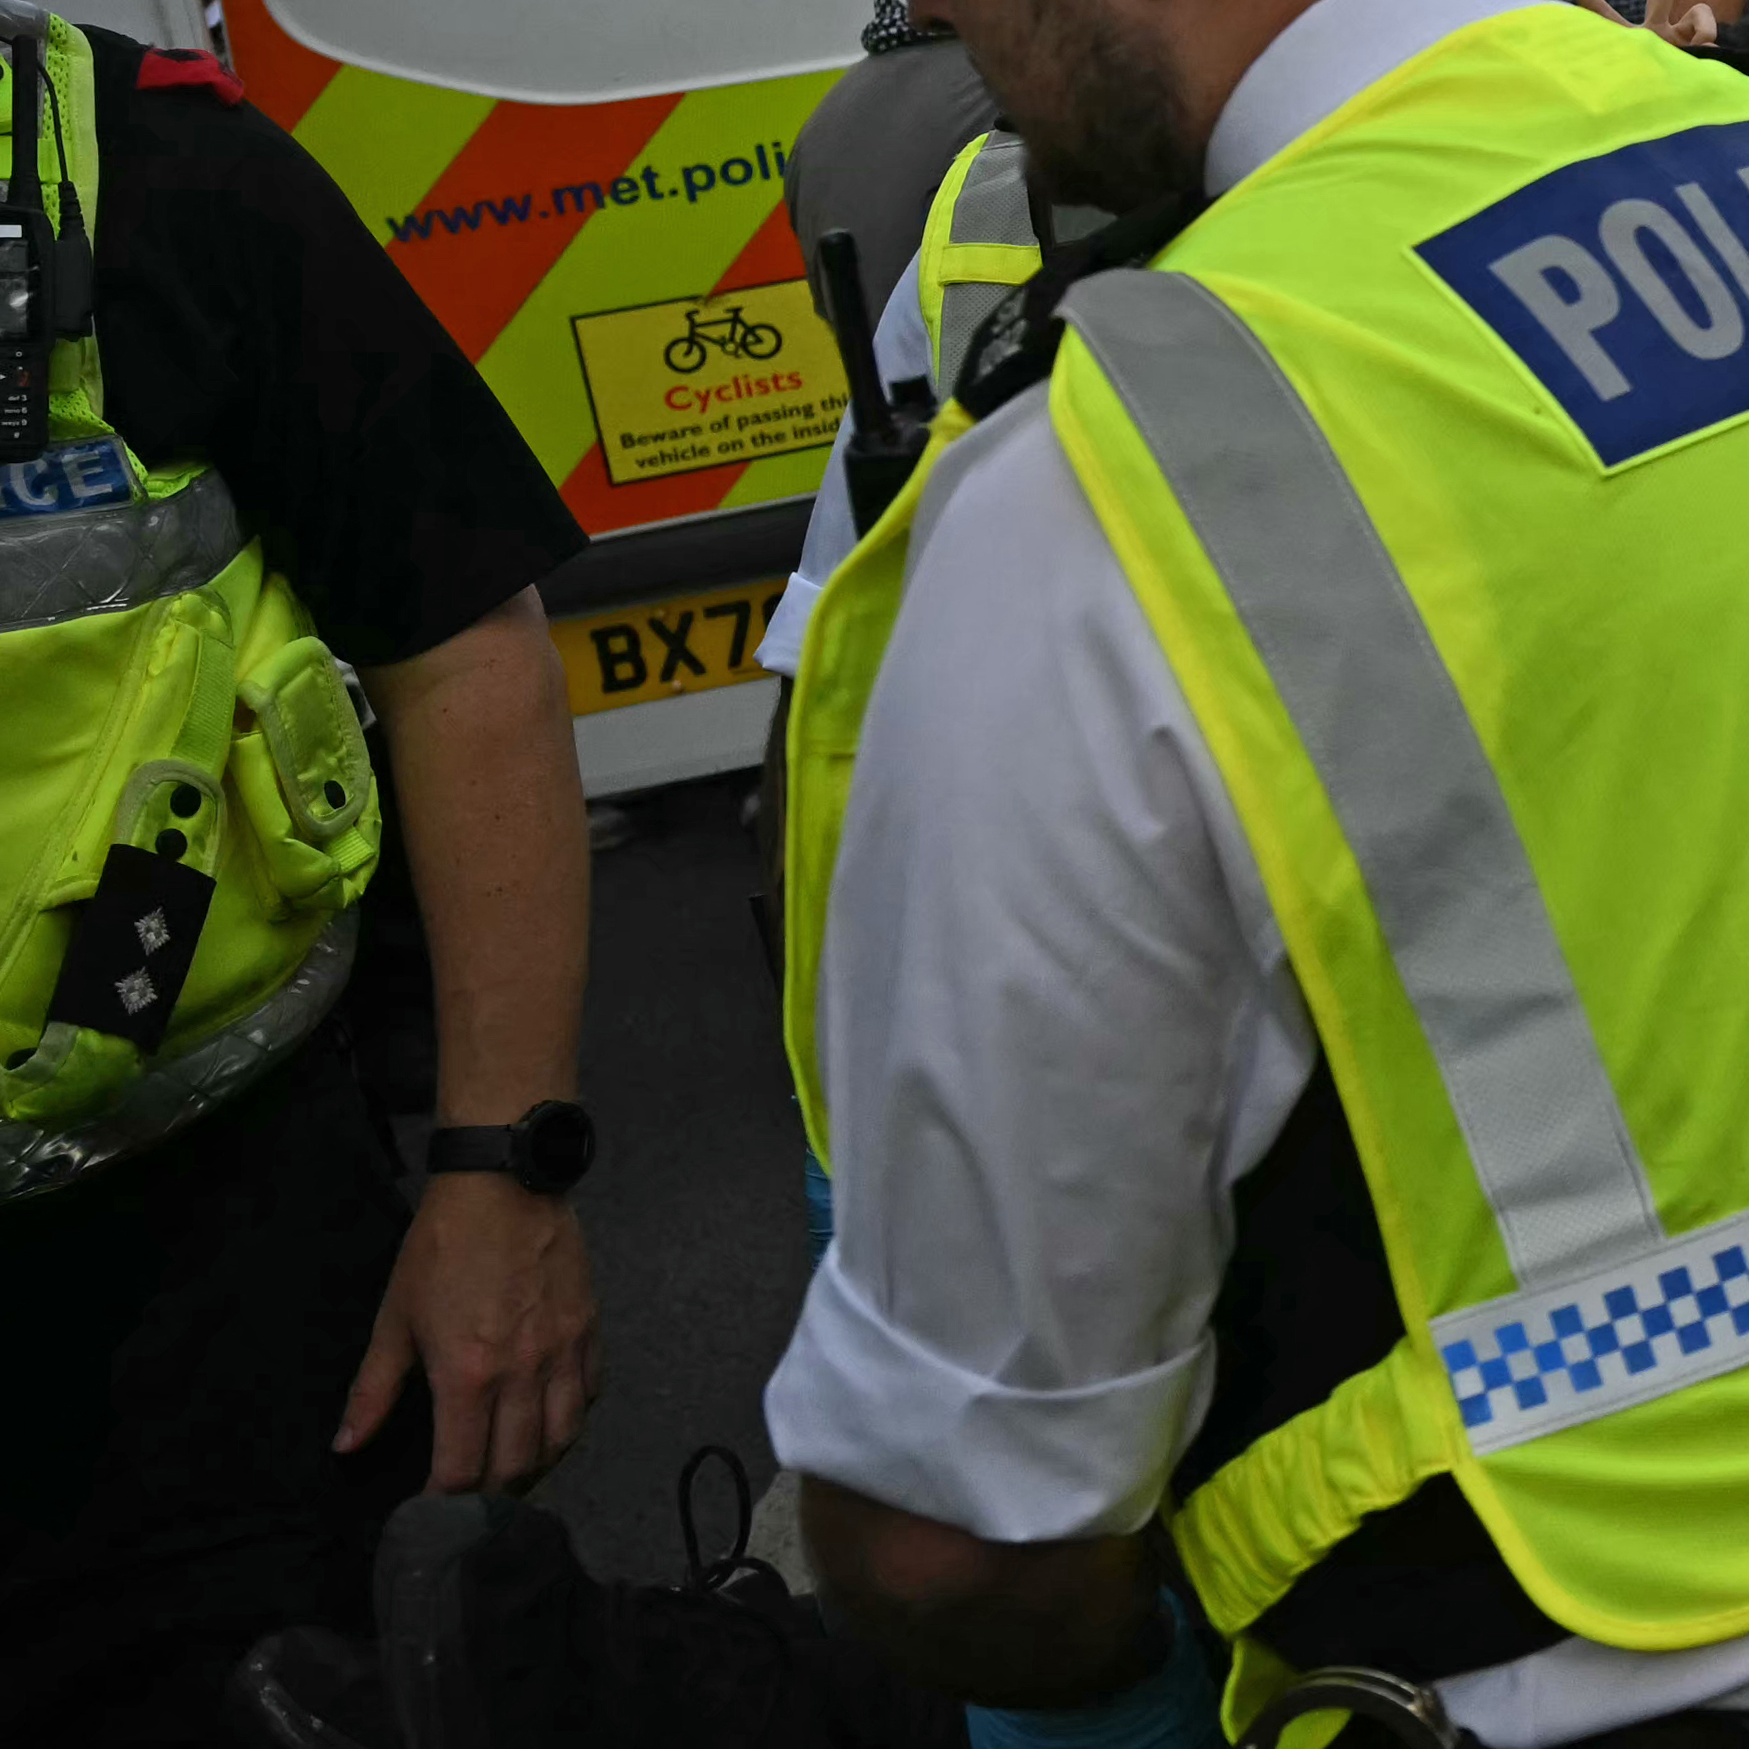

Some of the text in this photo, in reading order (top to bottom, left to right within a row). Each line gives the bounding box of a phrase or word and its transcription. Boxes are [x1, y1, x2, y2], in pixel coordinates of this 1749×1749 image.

[386, 141, 787, 242] www.met.poli
[664, 371, 803, 413] Cyclists
[620, 393, 849, 449] Beware of passing thi
[635, 418, 841, 469] vehicle on the insid
